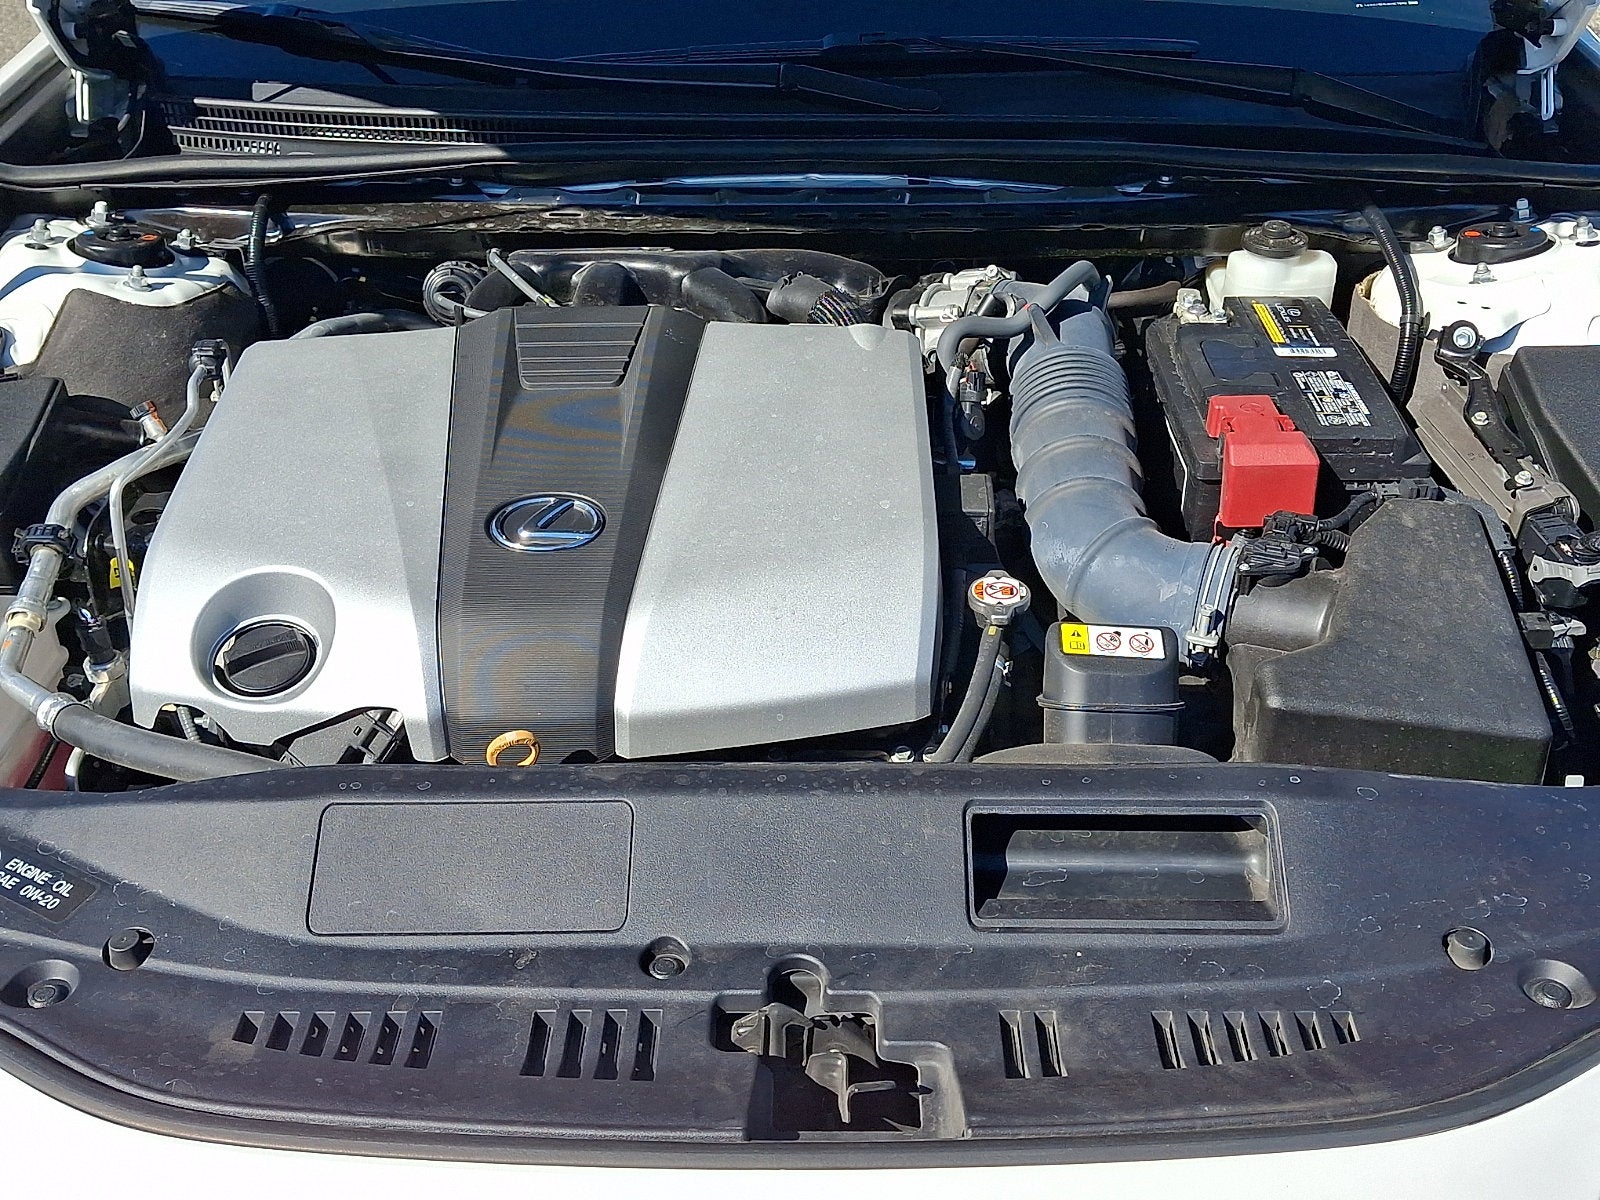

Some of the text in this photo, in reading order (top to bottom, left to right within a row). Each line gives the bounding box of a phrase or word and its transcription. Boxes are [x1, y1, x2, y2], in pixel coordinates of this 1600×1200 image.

[1275, 303, 1292, 323] LEXUS
[4, 857, 74, 898] ENGINE OIL
[19, 884, 61, 910] 0W-20
